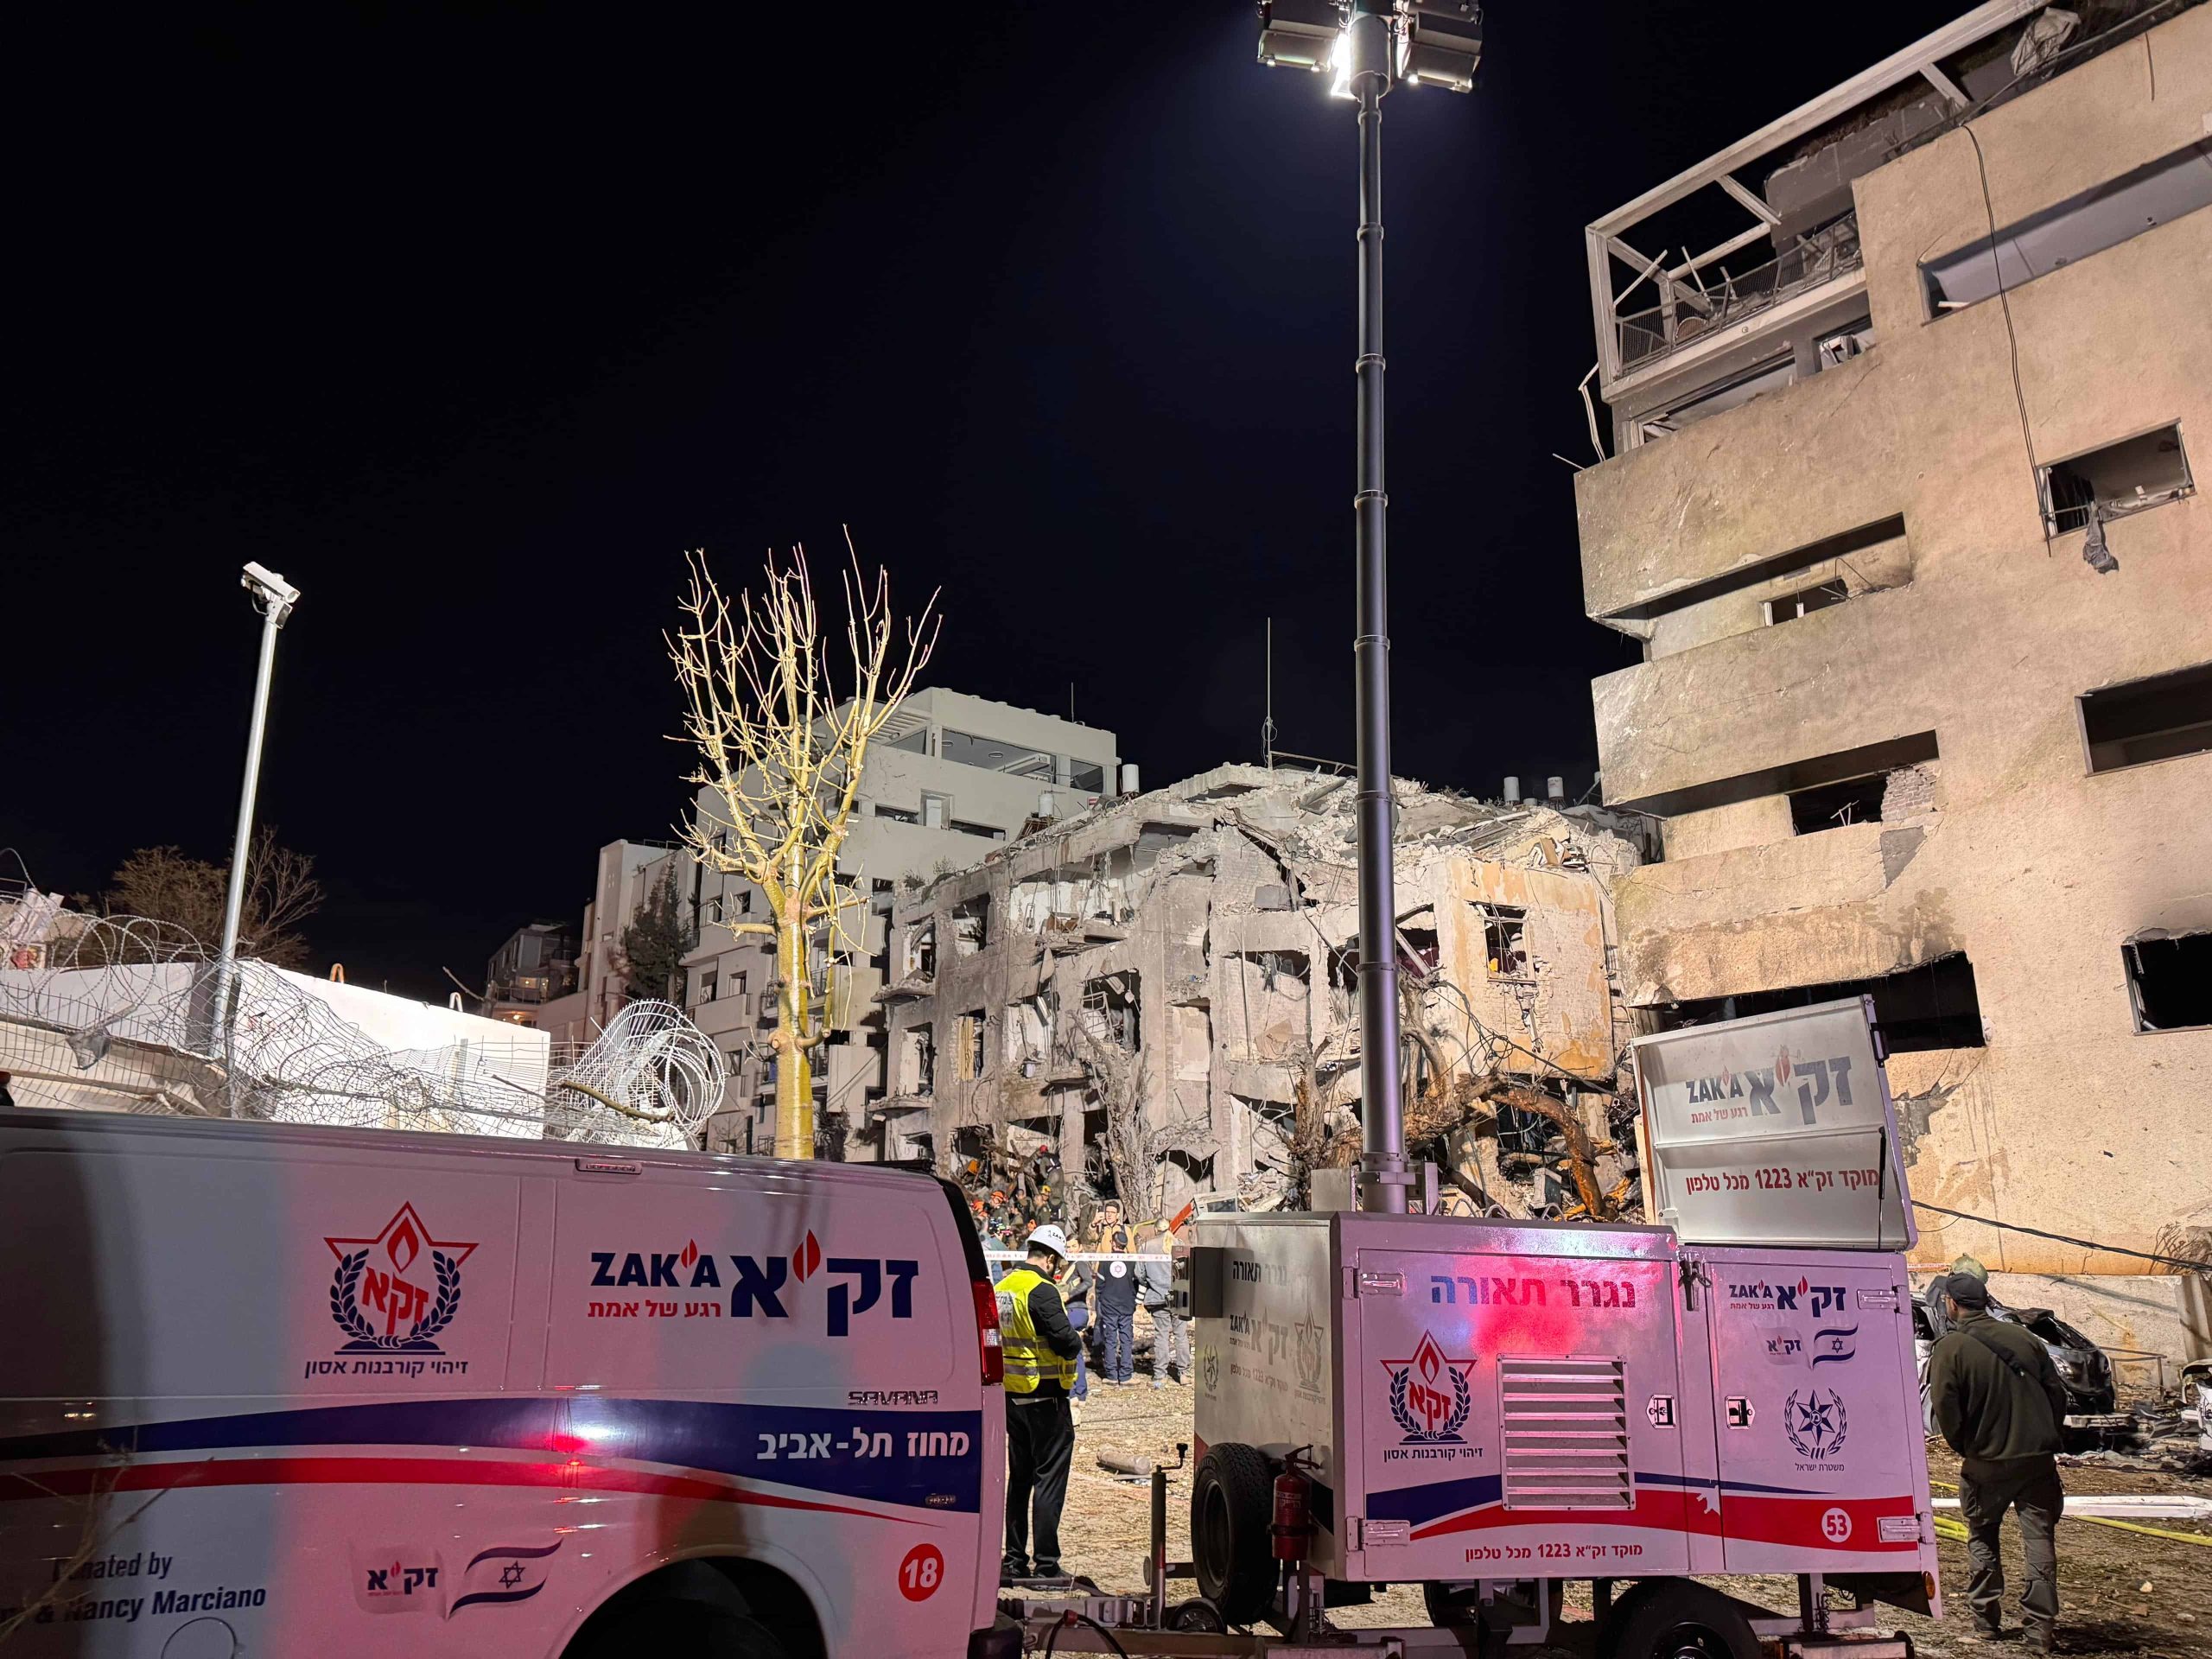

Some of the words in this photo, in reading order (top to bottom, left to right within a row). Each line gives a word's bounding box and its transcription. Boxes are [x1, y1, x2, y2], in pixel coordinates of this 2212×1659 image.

[1691, 1111, 1713, 1124] אמת
[1713, 1107, 1729, 1122] של
[1732, 1106, 1748, 1120] רגע
[1686, 1173, 1720, 1195] טלפון
[1726, 1172, 1750, 1192] מכל
[1755, 1167, 1792, 1190] 1223
[1839, 1168, 1879, 1192] מוקד
[1232, 1260, 1262, 1283] תאורה
[1430, 1274, 1547, 1306] תאורה
[1560, 1278, 1637, 1308] נגרר
[588, 1300, 639, 1319] אמת
[645, 1299, 678, 1319] של
[684, 1300, 721, 1319] רגע
[1748, 1301, 1760, 1310] של
[1761, 1302, 1775, 1311] רגע
[305, 1361, 347, 1379] אסון
[352, 1361, 425, 1378] קורבנות
[430, 1361, 468, 1375] זיהוי
[848, 1389, 938, 1406] SAVANA
[756, 1426, 893, 1460] תל-אביב
[907, 1431, 970, 1458] מחוז
[1383, 1449, 1409, 1463] אסון
[1411, 1448, 1456, 1462] קורבנות
[1459, 1447, 1484, 1459] זיהוי
[1795, 1461, 1817, 1472] ישראל
[1818, 1463, 1845, 1471] משטרת
[1827, 1514, 1847, 1536] 53
[1465, 1546, 1502, 1562] טלפון
[1505, 1545, 1531, 1559] מכל
[1537, 1543, 1571, 1558] 1223
[1611, 1544, 1643, 1558] מוקד
[147, 1551, 173, 1580] by
[905, 1557, 938, 1588] 18
[151, 1586, 267, 1615] Marciano
